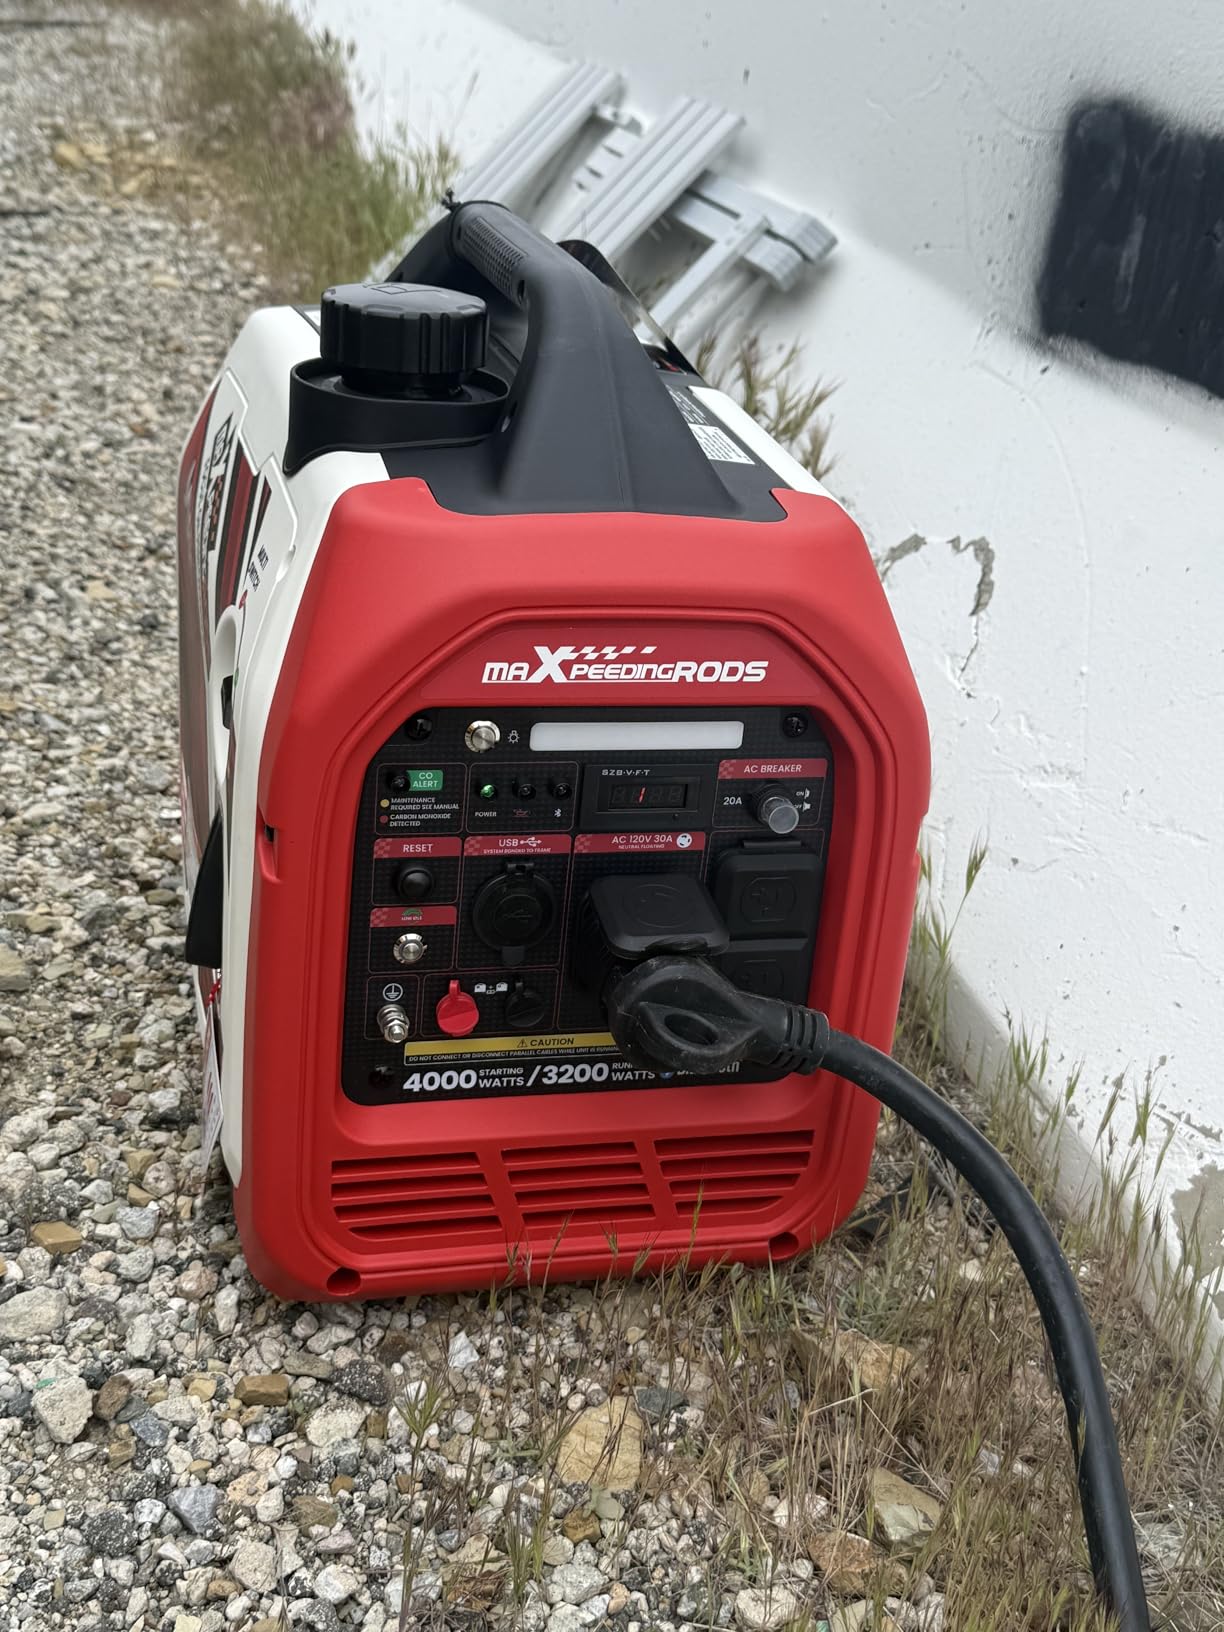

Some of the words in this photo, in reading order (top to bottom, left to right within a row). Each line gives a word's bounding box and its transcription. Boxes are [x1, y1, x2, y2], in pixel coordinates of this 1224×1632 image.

[744, 765, 758, 773] AC
[760, 764, 802, 773] BREAKER
[418, 772, 433, 780] CO
[412, 780, 438, 788] ALERT
[723, 796, 742, 806] 20A
[498, 839, 519, 847] USB
[611, 836, 626, 844] AC
[629, 835, 652, 844] 120V
[653, 834, 673, 843] 30A
[403, 843, 433, 853] RESET
[530, 1038, 575, 1047] CAUTION
[471, 1050, 509, 1058] DISCONNECT
[509, 1049, 536, 1057] PARALLEL
[479, 1067, 524, 1076] STARTING
[611, 1070, 655, 1081] WATTS
[403, 1069, 477, 1092] 4000
[479, 1077, 525, 1088] WATTS
